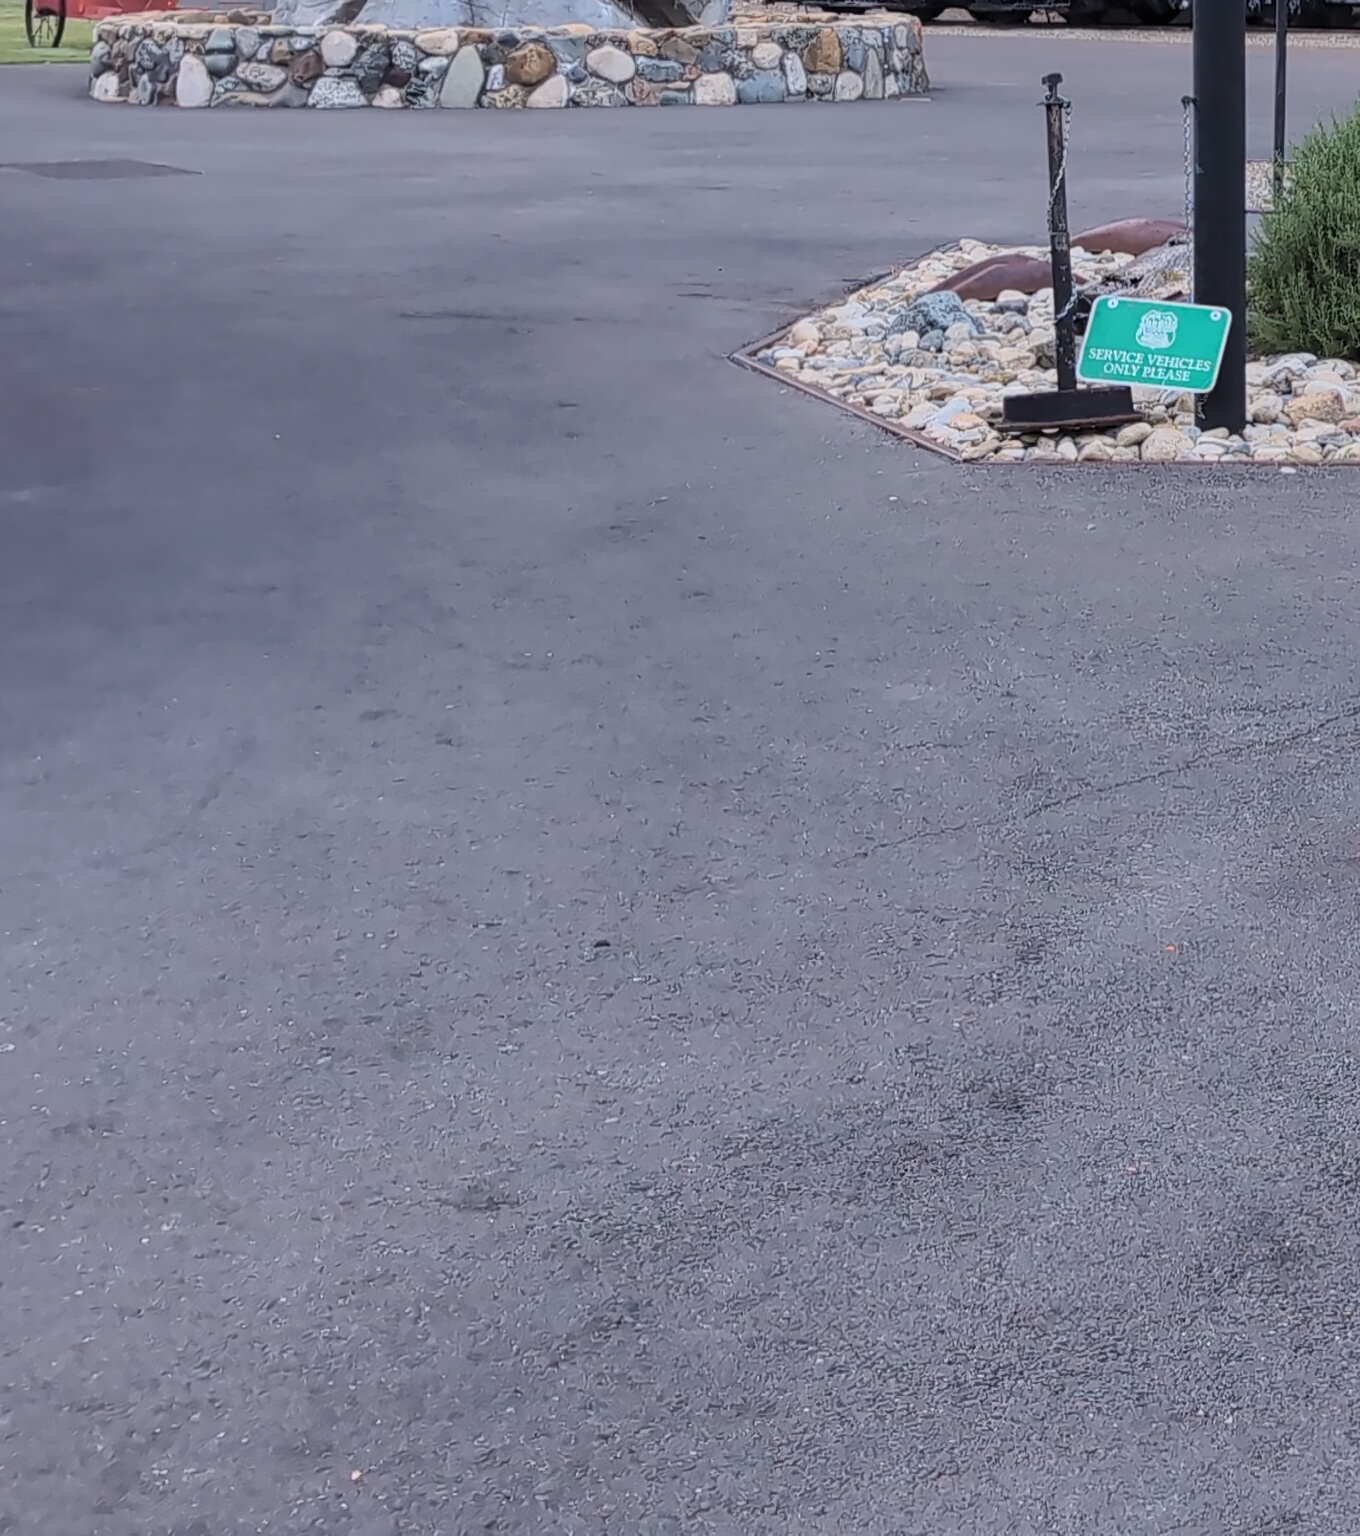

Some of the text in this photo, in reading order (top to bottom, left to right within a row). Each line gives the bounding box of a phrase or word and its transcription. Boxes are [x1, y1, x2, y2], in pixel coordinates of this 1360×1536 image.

[1088, 347, 1211, 371] SERVICE VEHICLES
[1103, 362, 1190, 381] ONLY PLEASE
